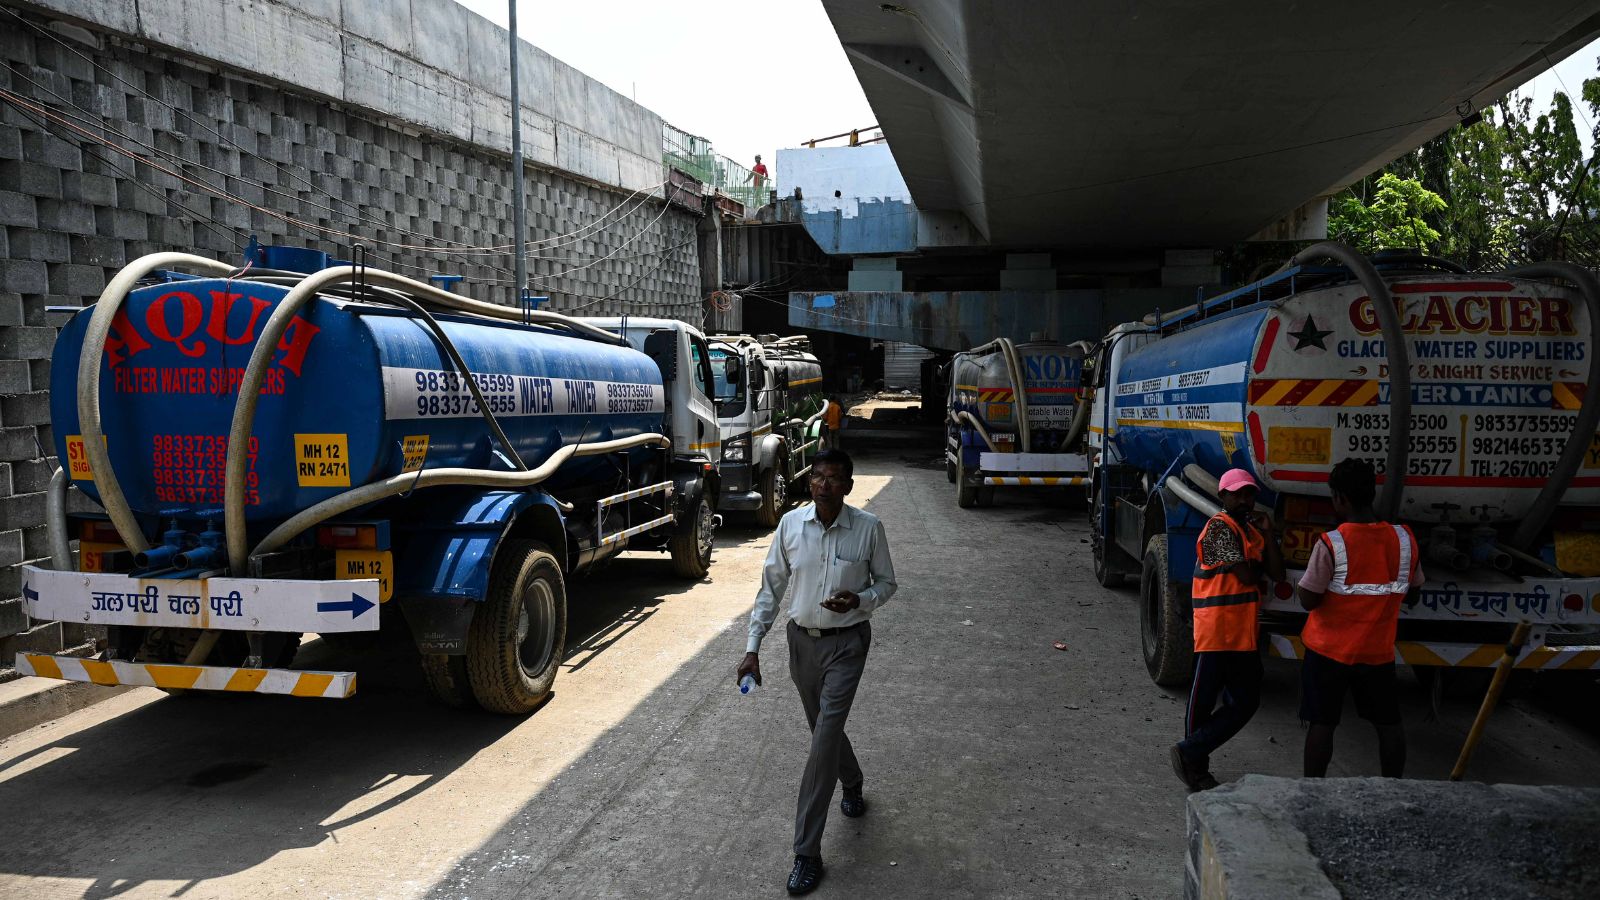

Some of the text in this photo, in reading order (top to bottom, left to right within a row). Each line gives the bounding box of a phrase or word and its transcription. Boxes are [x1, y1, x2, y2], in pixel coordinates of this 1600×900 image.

[1349, 295, 1578, 336] GLACIER
[102, 290, 321, 378] AQUA
[1337, 340, 1585, 361] GLACI WATER SUPPLIERS
[115, 367, 158, 393] FILTER
[161, 367, 207, 394] WATER
[1418, 365, 1430, 379] &
[1433, 365, 1484, 379] NIGHT
[1490, 366, 1553, 381] SERVICE
[519, 377, 597, 414] WATER TANKER
[1463, 385, 1535, 404] TANK
[1028, 407, 1073, 416] otable Water
[1474, 414, 1577, 433] 9833735599
[69, 441, 84, 460] ST
[303, 444, 340, 459] MH 12
[1348, 435, 1457, 453] 983335555
[1472, 437, 1567, 456] 982146533
[299, 461, 347, 477] RN 2471
[347, 561, 382, 575] MH 12
[168, 594, 200, 614] चल
[210, 590, 243, 616] परी
[1468, 591, 1510, 618] चल
[1513, 584, 1550, 619] परी
